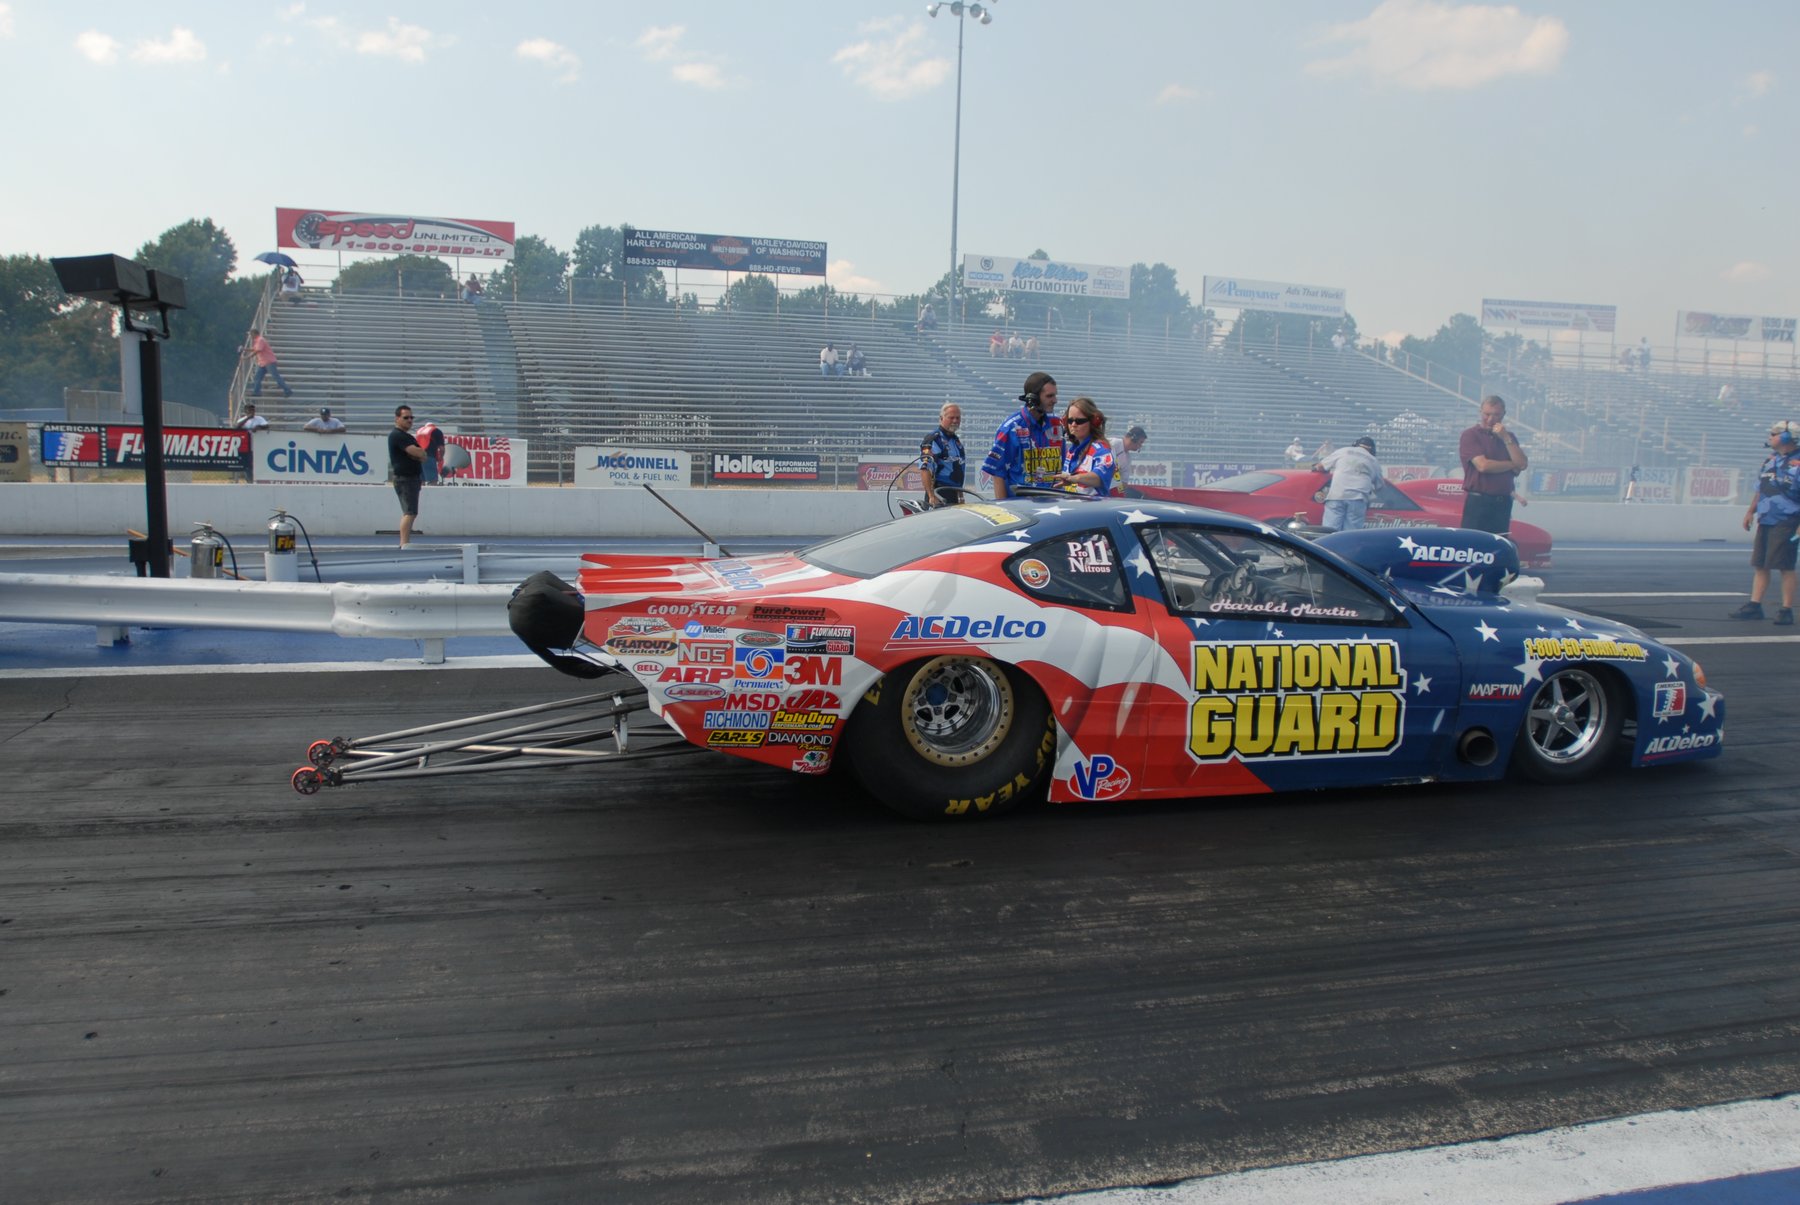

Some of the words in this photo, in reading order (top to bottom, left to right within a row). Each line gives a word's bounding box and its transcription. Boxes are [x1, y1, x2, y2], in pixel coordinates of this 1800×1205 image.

[413, 232, 491, 244] UNLIMITED
[634, 231, 652, 240] ALL
[652, 232, 697, 243] AMERICAN
[345, 240, 505, 257] 1-800-SPEED-LT
[626, 238, 707, 251] HARLEY-DAVIDSON
[751, 238, 826, 251] HARLEY-DAVIDSON
[755, 246, 767, 255] OF
[768, 247, 822, 258] WASHINGTON
[626, 256, 678, 267] 888-833-2REV
[748, 263, 802, 274] 888-HD-FEVER
[1010, 279, 1088, 295] AUTOMOTIVE
[1227, 280, 1281, 300] Pennysaver
[1285, 286, 1300, 295] Ads
[1302, 287, 1319, 297] That
[44, 424, 99, 433] AMERICAN
[0, 431, 23, 440] nc.
[116, 433, 242, 463] FLMASTER
[714, 454, 775, 479] Holley
[1130, 463, 1167, 476] rew's
[1193, 463, 1220, 471] WELCOME
[609, 471, 632, 480] POOL
[633, 472, 641, 481] &
[642, 473, 662, 481] FUEL
[664, 473, 680, 482] INC.
[1563, 471, 1617, 492] FLOWMASTER
[1634, 486, 1672, 498] ENCE
[1689, 478, 1730, 497] GUARD
[1412, 545, 1495, 565] ACDelco
[1067, 557, 1111, 573] Nitrous
[753, 606, 826, 617] PurePower!
[1209, 598, 1288, 613] Harold
[1290, 603, 1359, 618] Martin
[702, 626, 727, 634] Miller
[890, 614, 1047, 639] ACDelco
[809, 627, 852, 640] FLOWMASTER
[614, 639, 669, 650] FLATOUT
[827, 644, 849, 653] GUARD
[1525, 638, 1646, 661] 1-800-GO-GUARD.com
[680, 643, 734, 662] NOS
[636, 664, 660, 672] BELL
[784, 655, 842, 686] 3M
[1194, 643, 1401, 691] NATIONAL
[656, 667, 734, 683] ARP
[734, 679, 780, 689] Permatex
[704, 711, 769, 729] RICHMOND
[1189, 690, 1400, 757] GUARD
[709, 732, 762, 742] EARL'S
[768, 732, 833, 745] DIAMOND
[1643, 733, 1715, 755] ACDelco
[1073, 754, 1116, 800] VP
[944, 771, 1031, 814] YEAR
